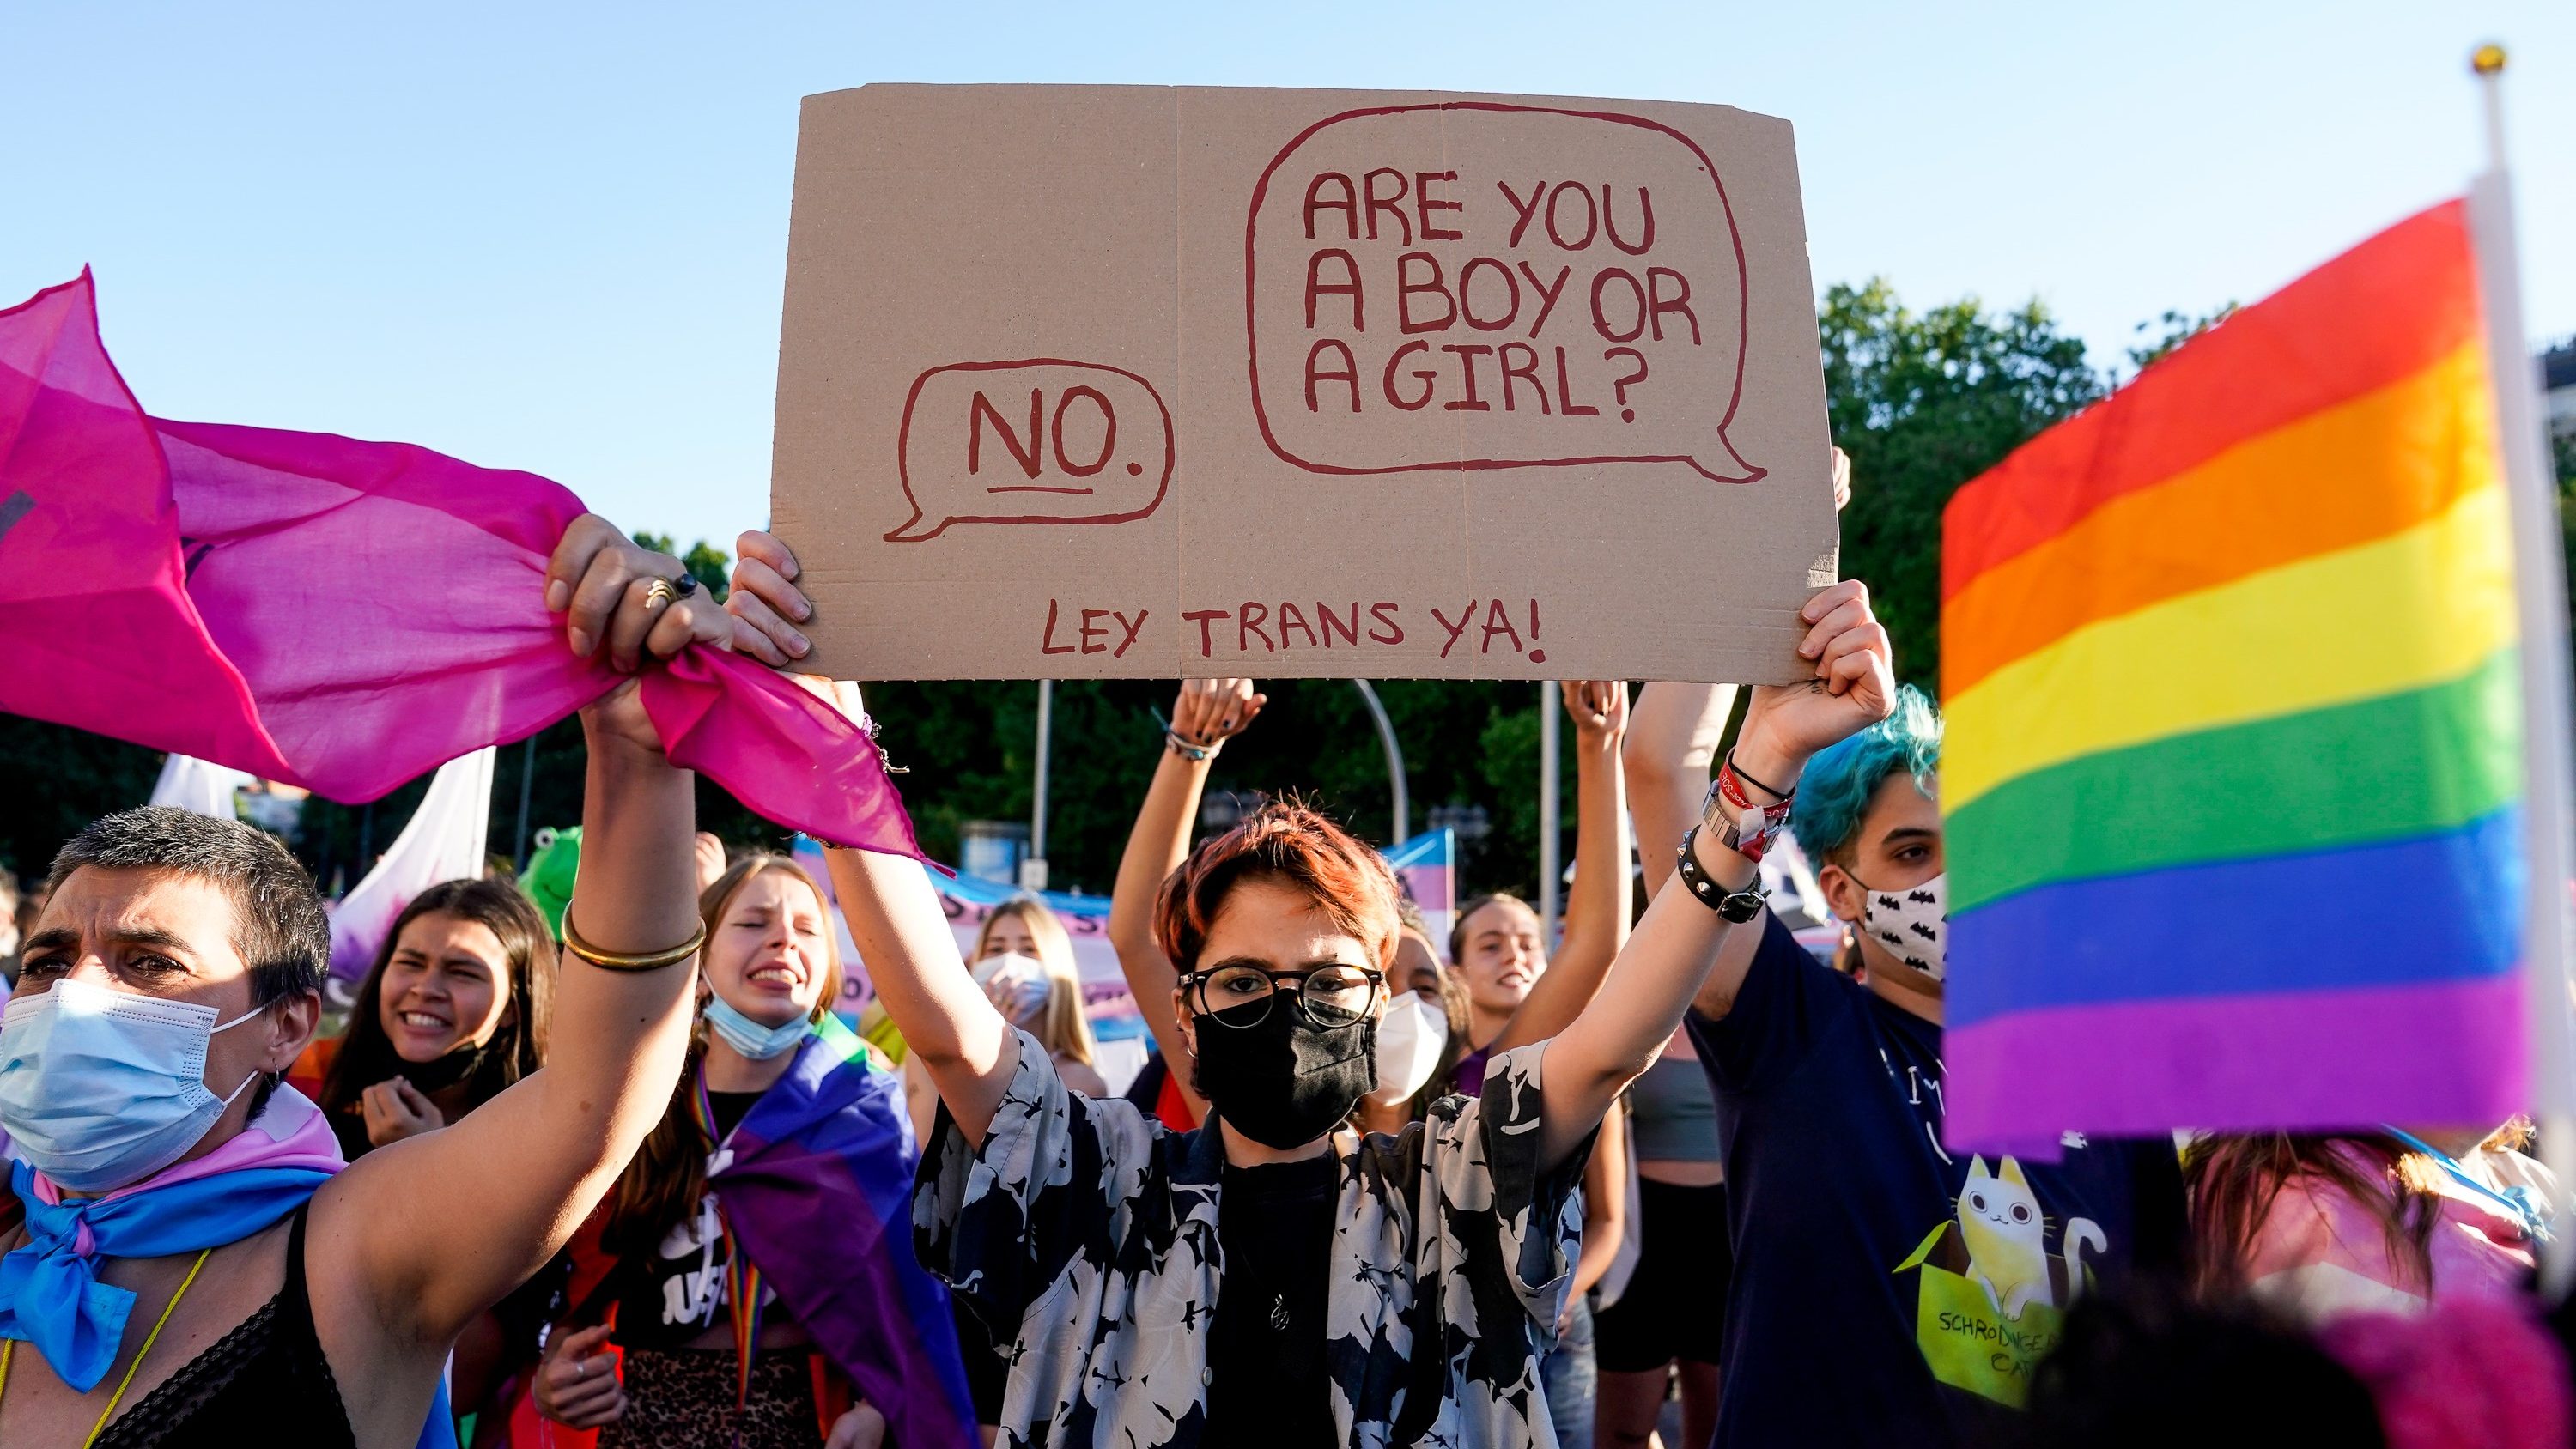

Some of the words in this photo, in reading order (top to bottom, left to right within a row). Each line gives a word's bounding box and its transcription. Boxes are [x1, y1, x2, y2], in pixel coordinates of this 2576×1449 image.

[1303, 167, 1464, 246] ARE
[1496, 180, 1656, 256] YOU
[1303, 248, 1365, 333] A
[1396, 251, 1571, 340] BOY
[1589, 267, 1702, 345] OR
[1303, 338, 1362, 414] A
[1382, 340, 1649, 423] GIRL?
[968, 384, 1143, 478] NO.
[1042, 598, 1149, 659] LEY
[1181, 601, 1405, 658] TRANS
[1431, 598, 1546, 664] YA!
